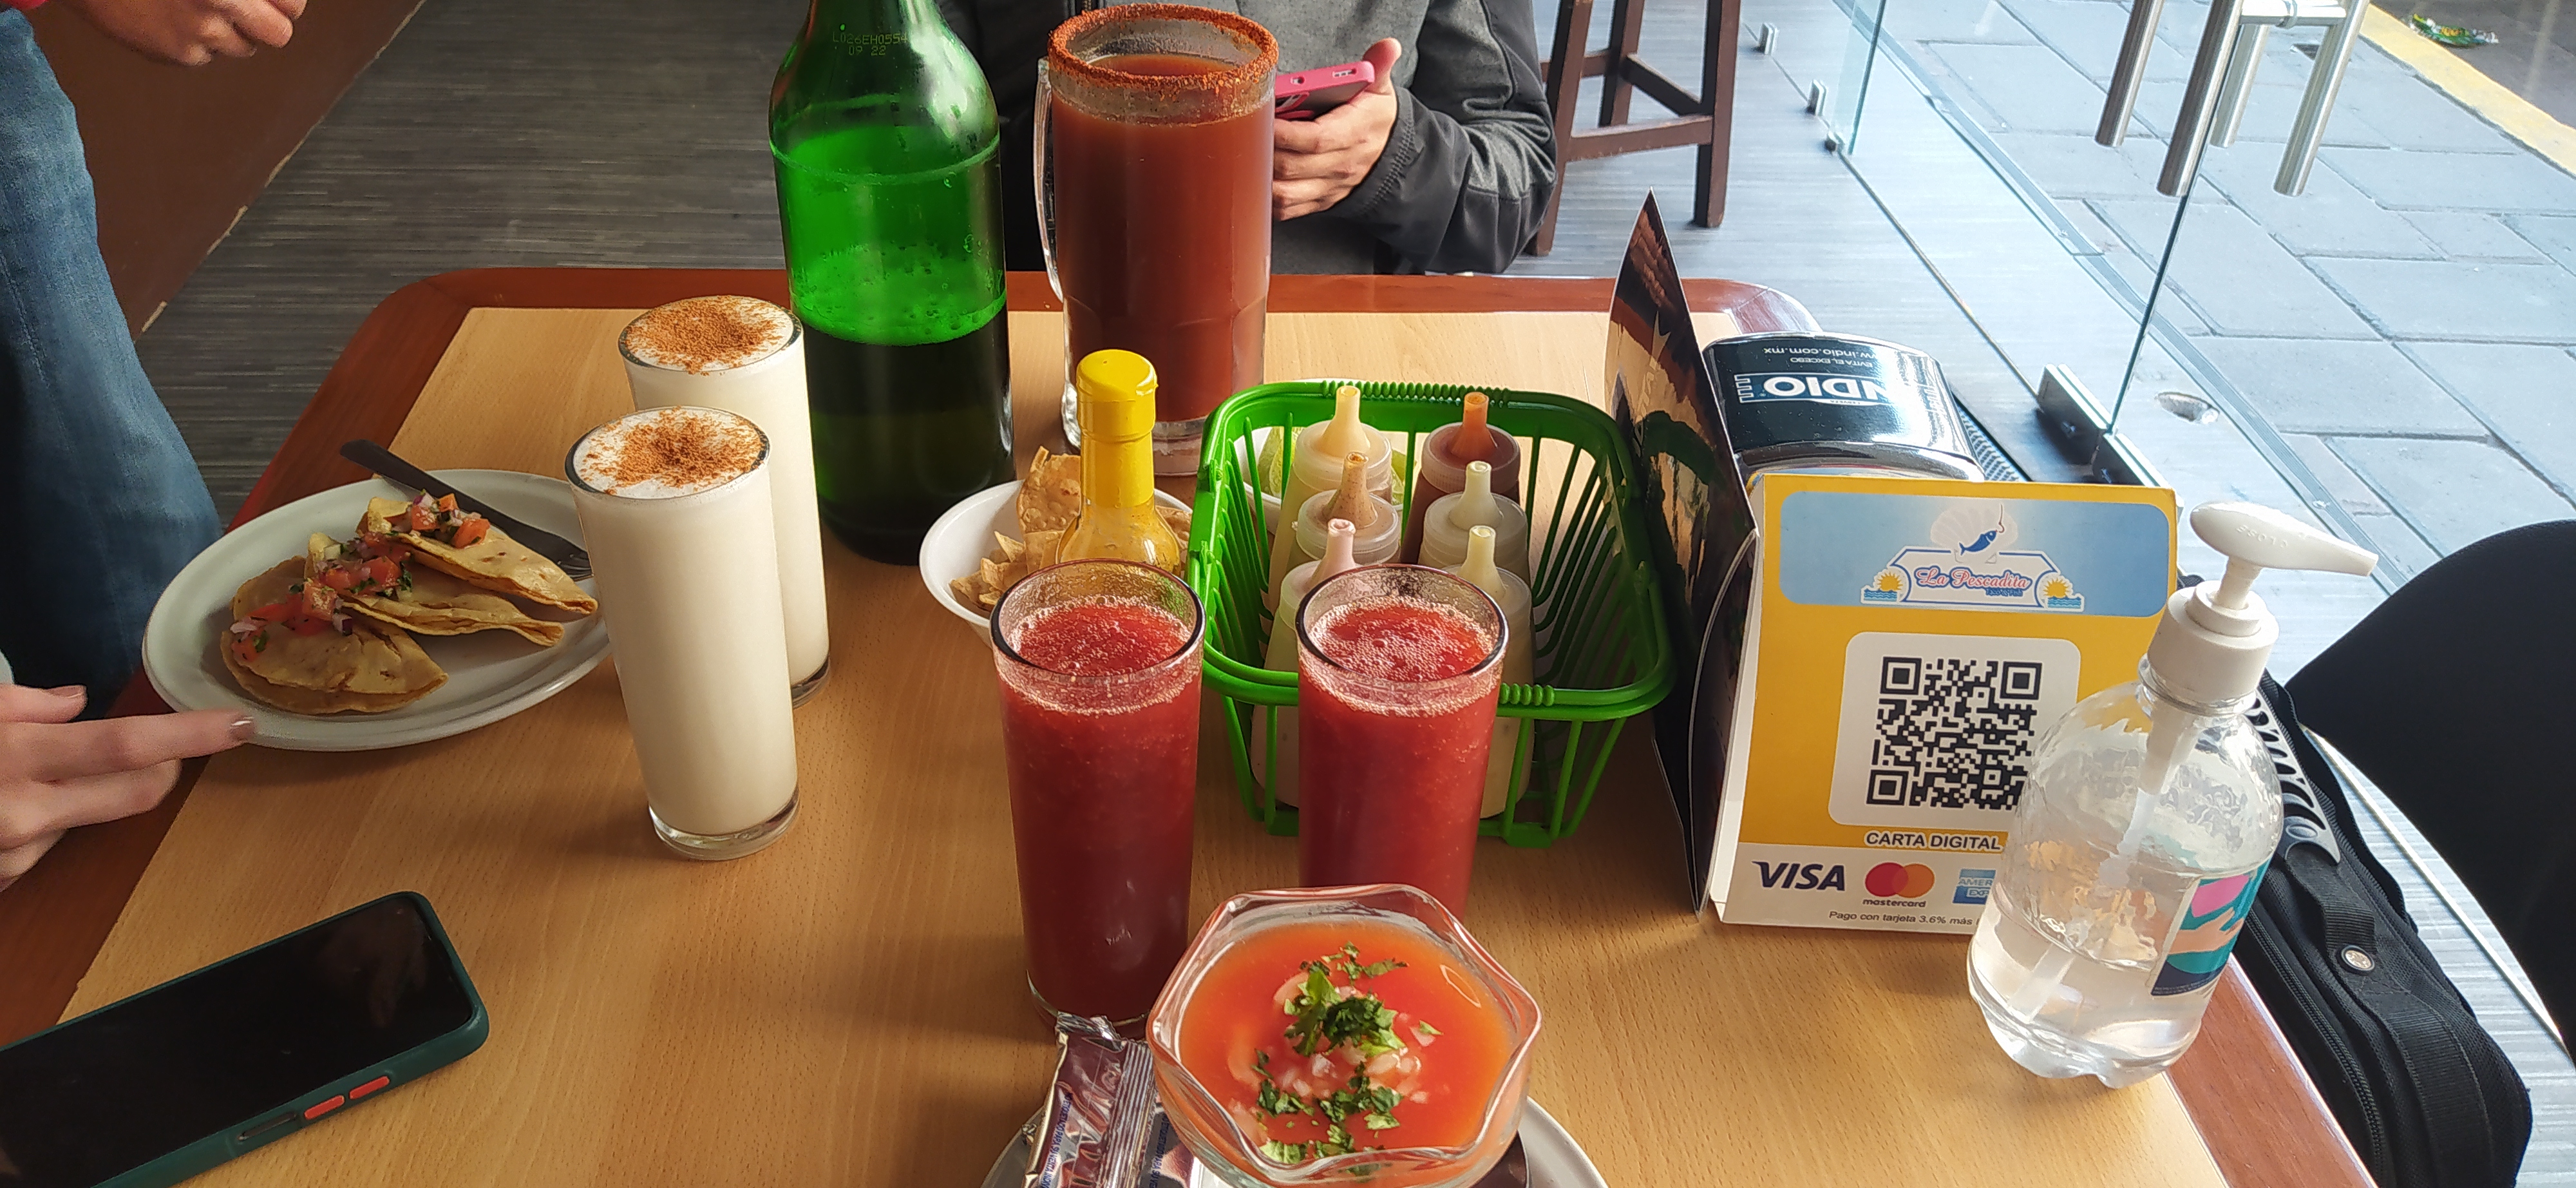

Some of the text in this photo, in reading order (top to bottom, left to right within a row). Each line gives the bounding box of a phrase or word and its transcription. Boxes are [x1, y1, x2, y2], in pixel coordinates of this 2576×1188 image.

[871, 45, 886, 56] 22
[1763, 376, 1886, 401] NDIO
[1917, 568, 1949, 586] La
[1866, 832, 2000, 850] CARTA DIGITAL
[1751, 861, 1846, 892] VISA
[1958, 878, 1993, 886] AMER
[1862, 898, 1927, 908] mastercard
[1829, 911, 1857, 921] Pago
[1882, 914, 1916, 924] tarjeta
[1918, 915, 1946, 924] 3.6%
[1949, 917, 1973, 925] más
